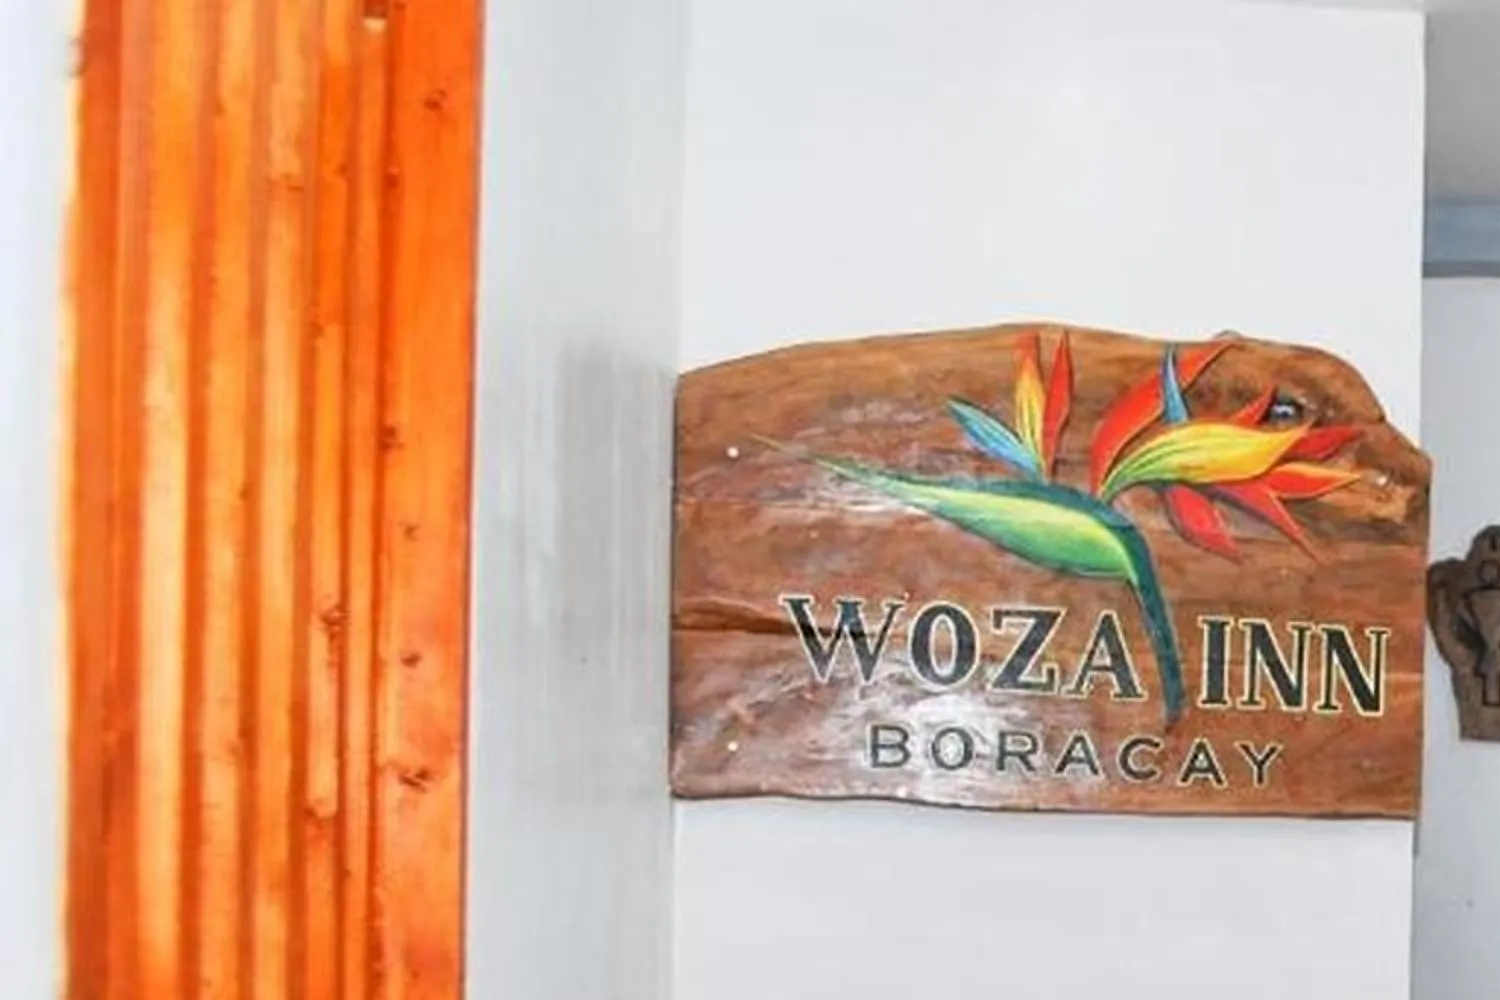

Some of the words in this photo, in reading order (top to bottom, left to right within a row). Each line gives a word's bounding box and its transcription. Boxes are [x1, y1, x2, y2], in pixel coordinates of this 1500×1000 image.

[780, 593, 1146, 702] WOZA
[1198, 614, 1391, 716] INN
[868, 723, 1285, 788] BORACAY
